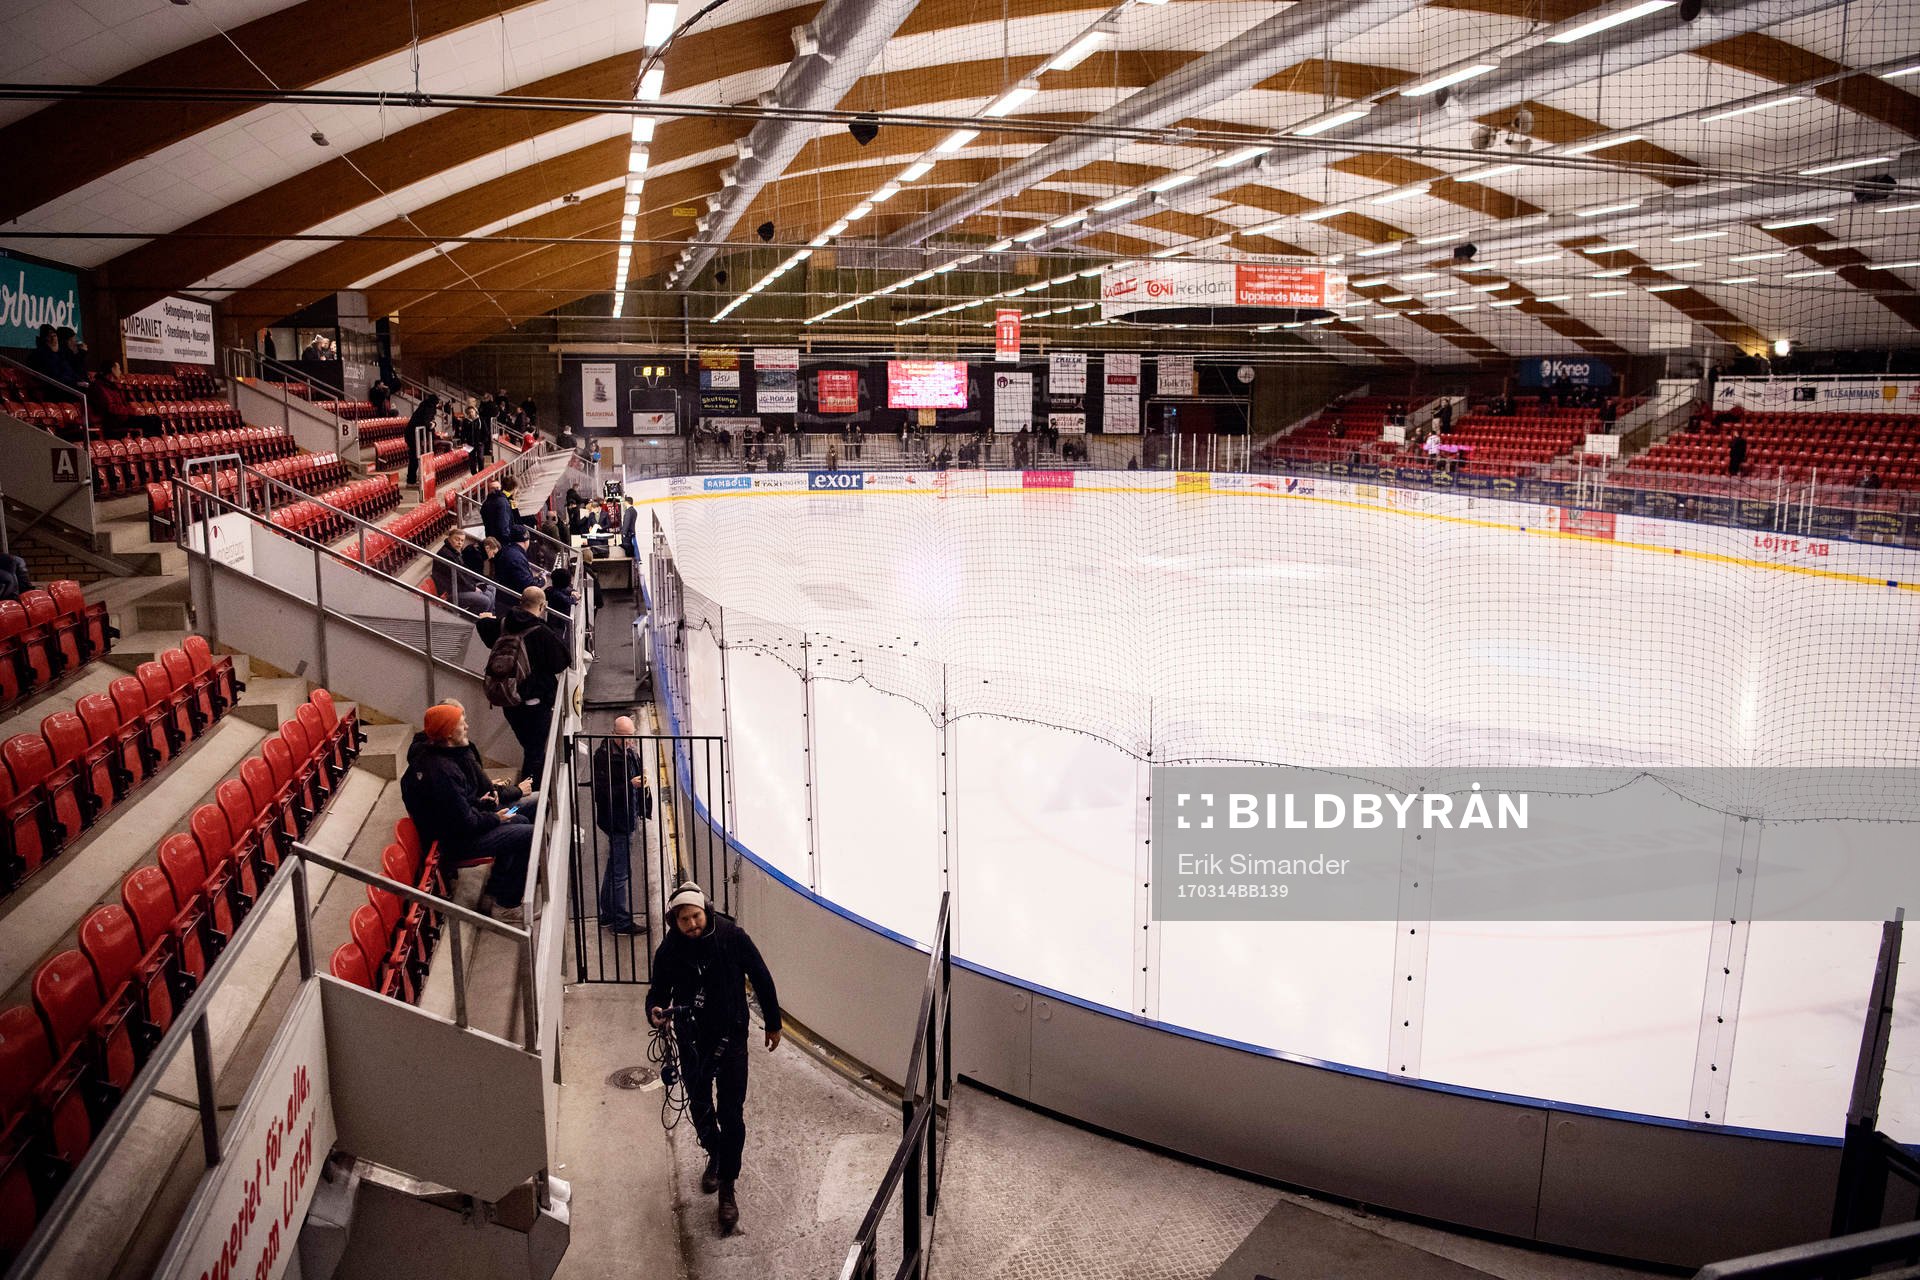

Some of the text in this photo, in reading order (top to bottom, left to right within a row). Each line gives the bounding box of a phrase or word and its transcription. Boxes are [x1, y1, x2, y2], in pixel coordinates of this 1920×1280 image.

[0, 271, 78, 333] rhuset
[1240, 291, 1319, 303] Upplands Motor
[1003, 326, 1014, 345] 11
[1824, 389, 1880, 399] TILLSAMMANS
[342, 424, 349, 436] B
[57, 450, 75, 474] A
[810, 472, 862, 488] .exor
[1806, 543, 1829, 557] AB
[200, 1159, 261, 1280] geriet
[265, 1115, 284, 1186] för
